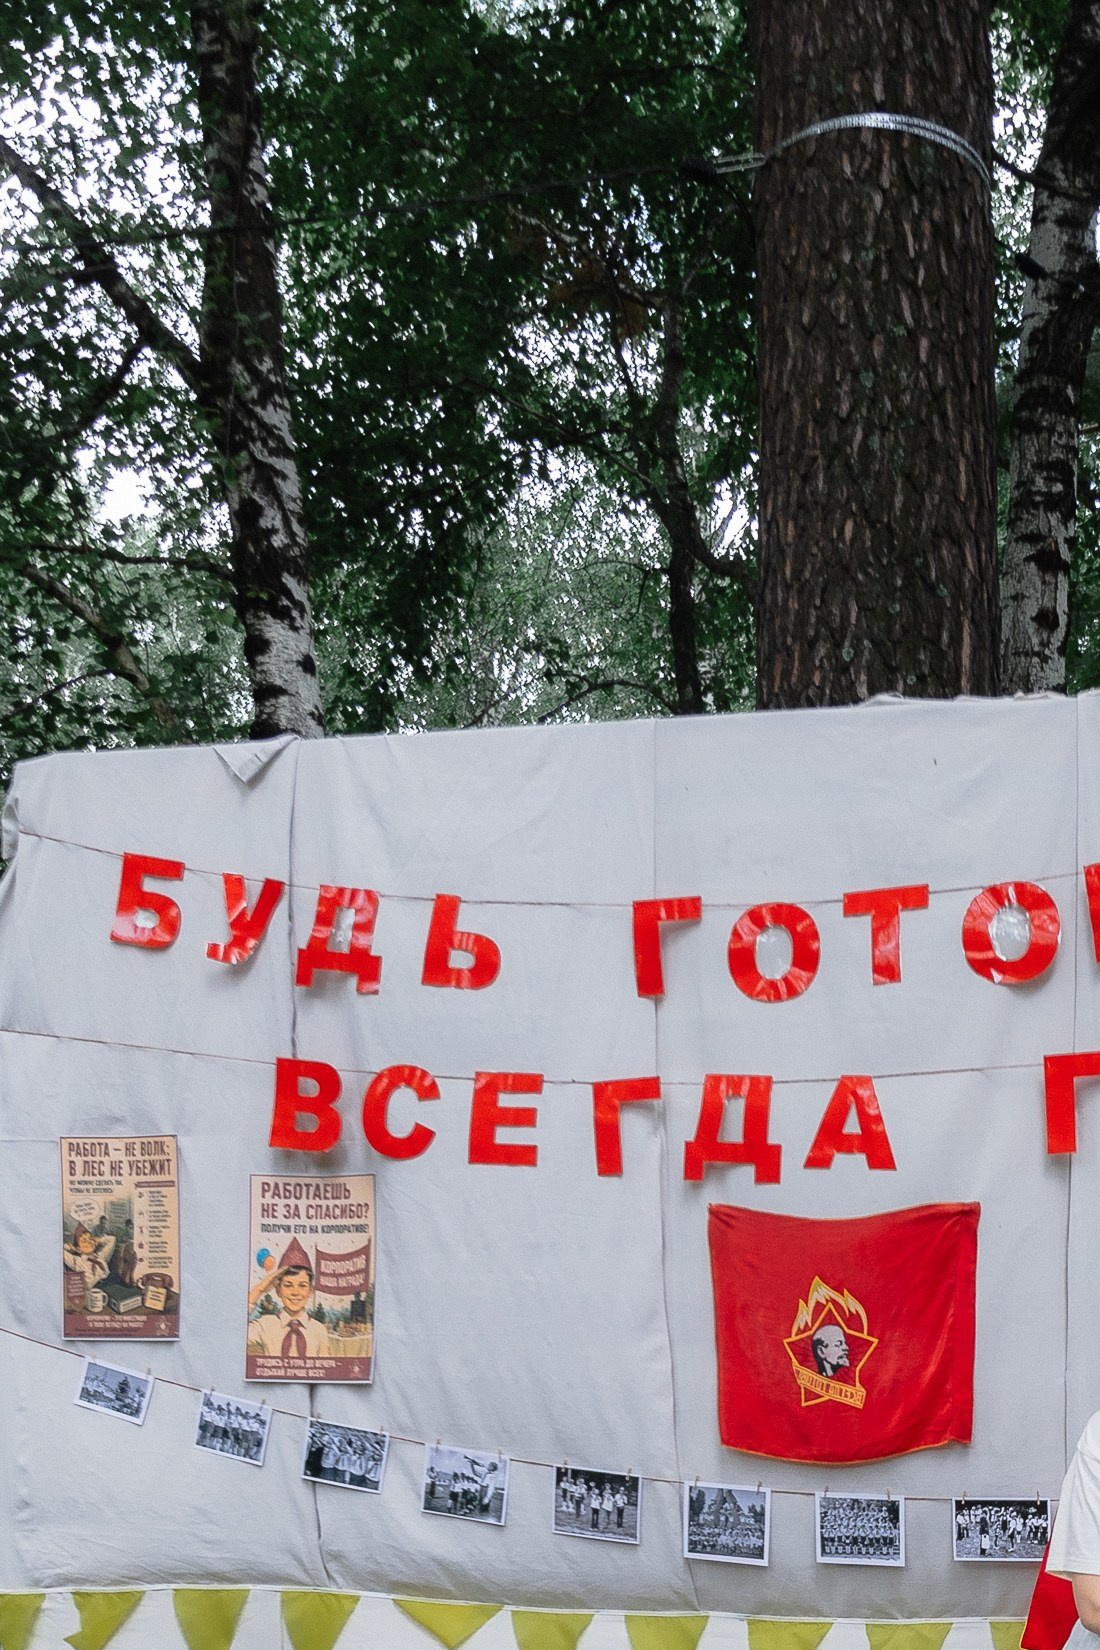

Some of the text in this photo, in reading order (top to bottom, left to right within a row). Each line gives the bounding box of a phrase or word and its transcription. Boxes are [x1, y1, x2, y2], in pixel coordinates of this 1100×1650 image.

[109, 852, 501, 995] БУДЬ
[267, 1057, 898, 1185] ВСЕГДА
[68, 1141, 110, 1158] РАБОТА
[125, 1142, 137, 1158] НЕ
[140, 1140, 170, 1157] ВОЛК:
[69, 1159, 172, 1177] В ЛЕС НЕ УБЕЖИТ
[261, 1181, 351, 1200] РАБОТАЕШЬ
[261, 1203, 370, 1220] НЕ ЗА СПАСИБО?
[261, 1223, 370, 1234] ПОЛУЧИ ЕГО НА КОРПОРАТИВЕ!
